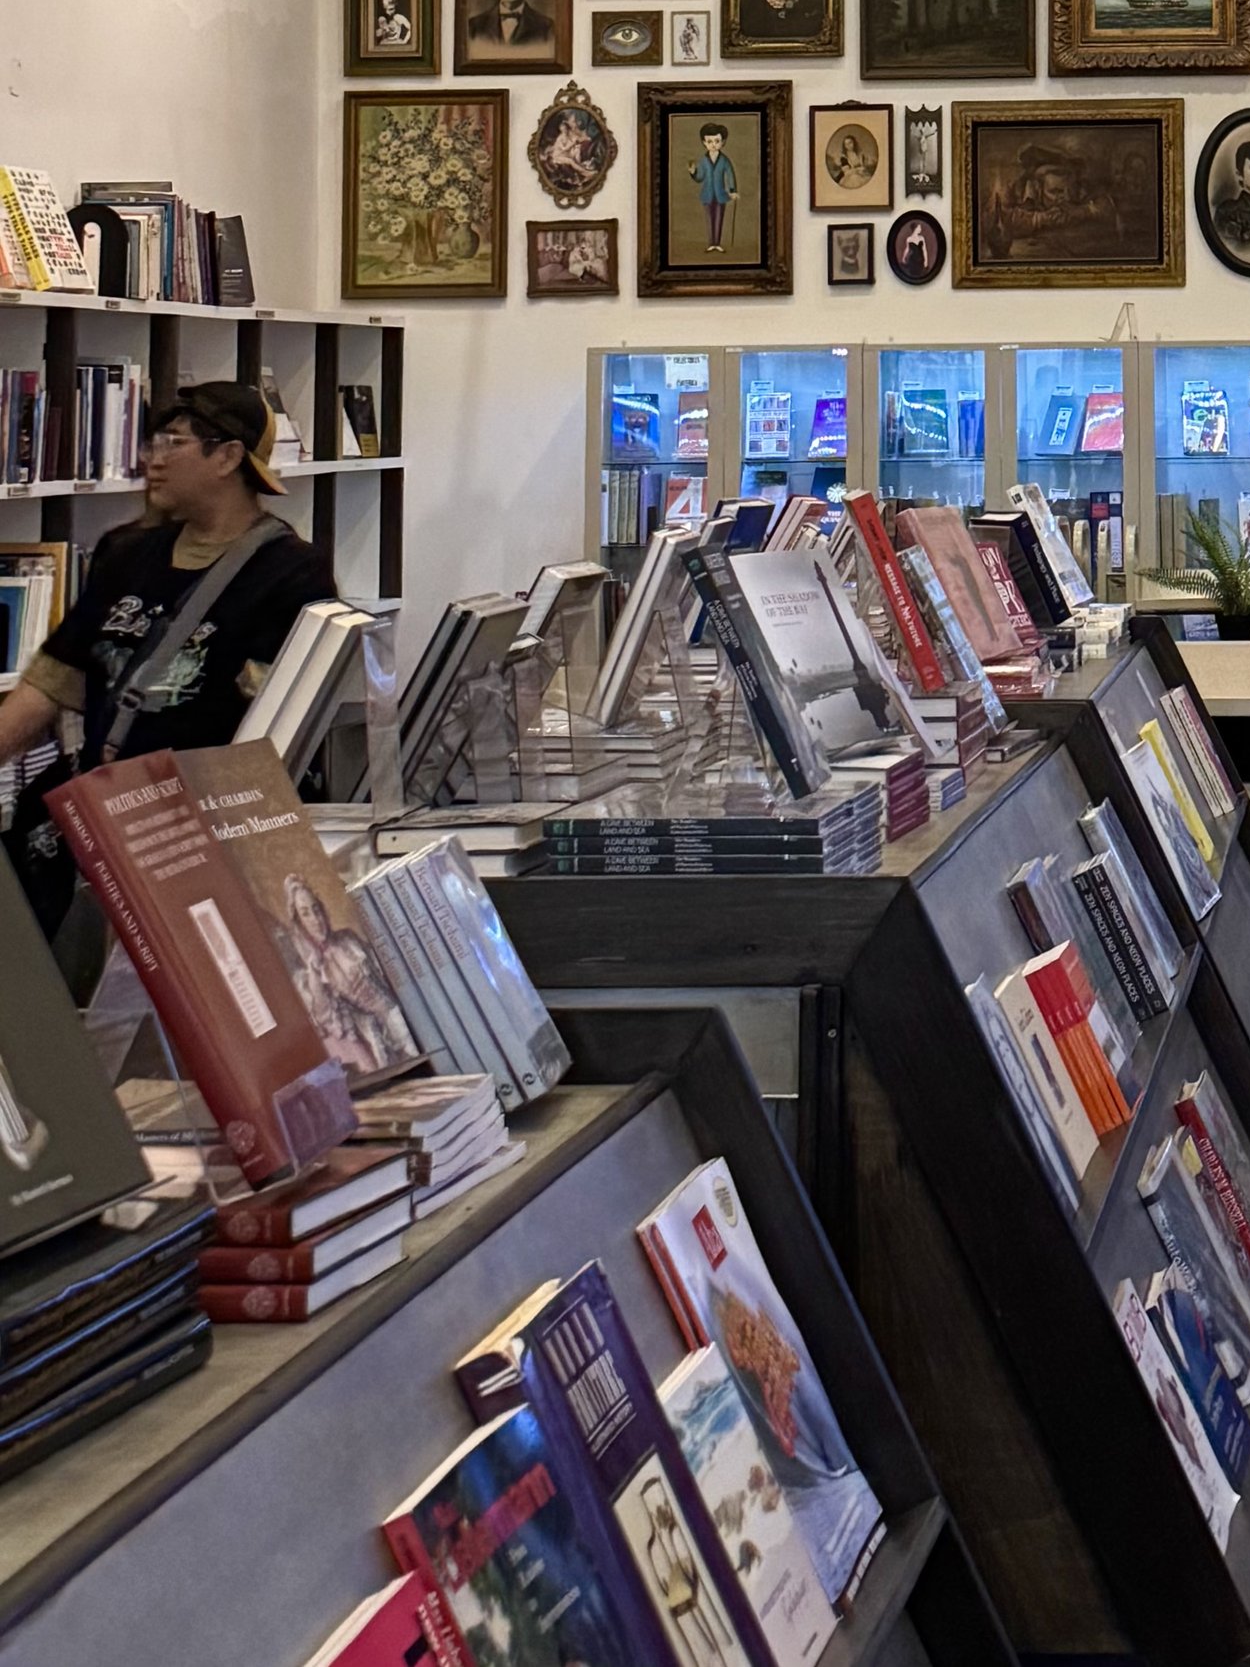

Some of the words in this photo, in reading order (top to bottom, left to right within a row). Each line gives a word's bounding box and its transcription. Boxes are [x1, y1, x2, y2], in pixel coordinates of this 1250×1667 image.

[219, 788, 264, 809] CHARDIN
[63, 799, 95, 852] MORISON
[249, 811, 300, 833] Manners
[1091, 906, 1109, 937] SPACES
[1122, 973, 1140, 1003] PLACES
[1106, 895, 1124, 929] SPACES
[1137, 966, 1155, 994] PLACES
[1199, 1138, 1223, 1178] CHARLES
